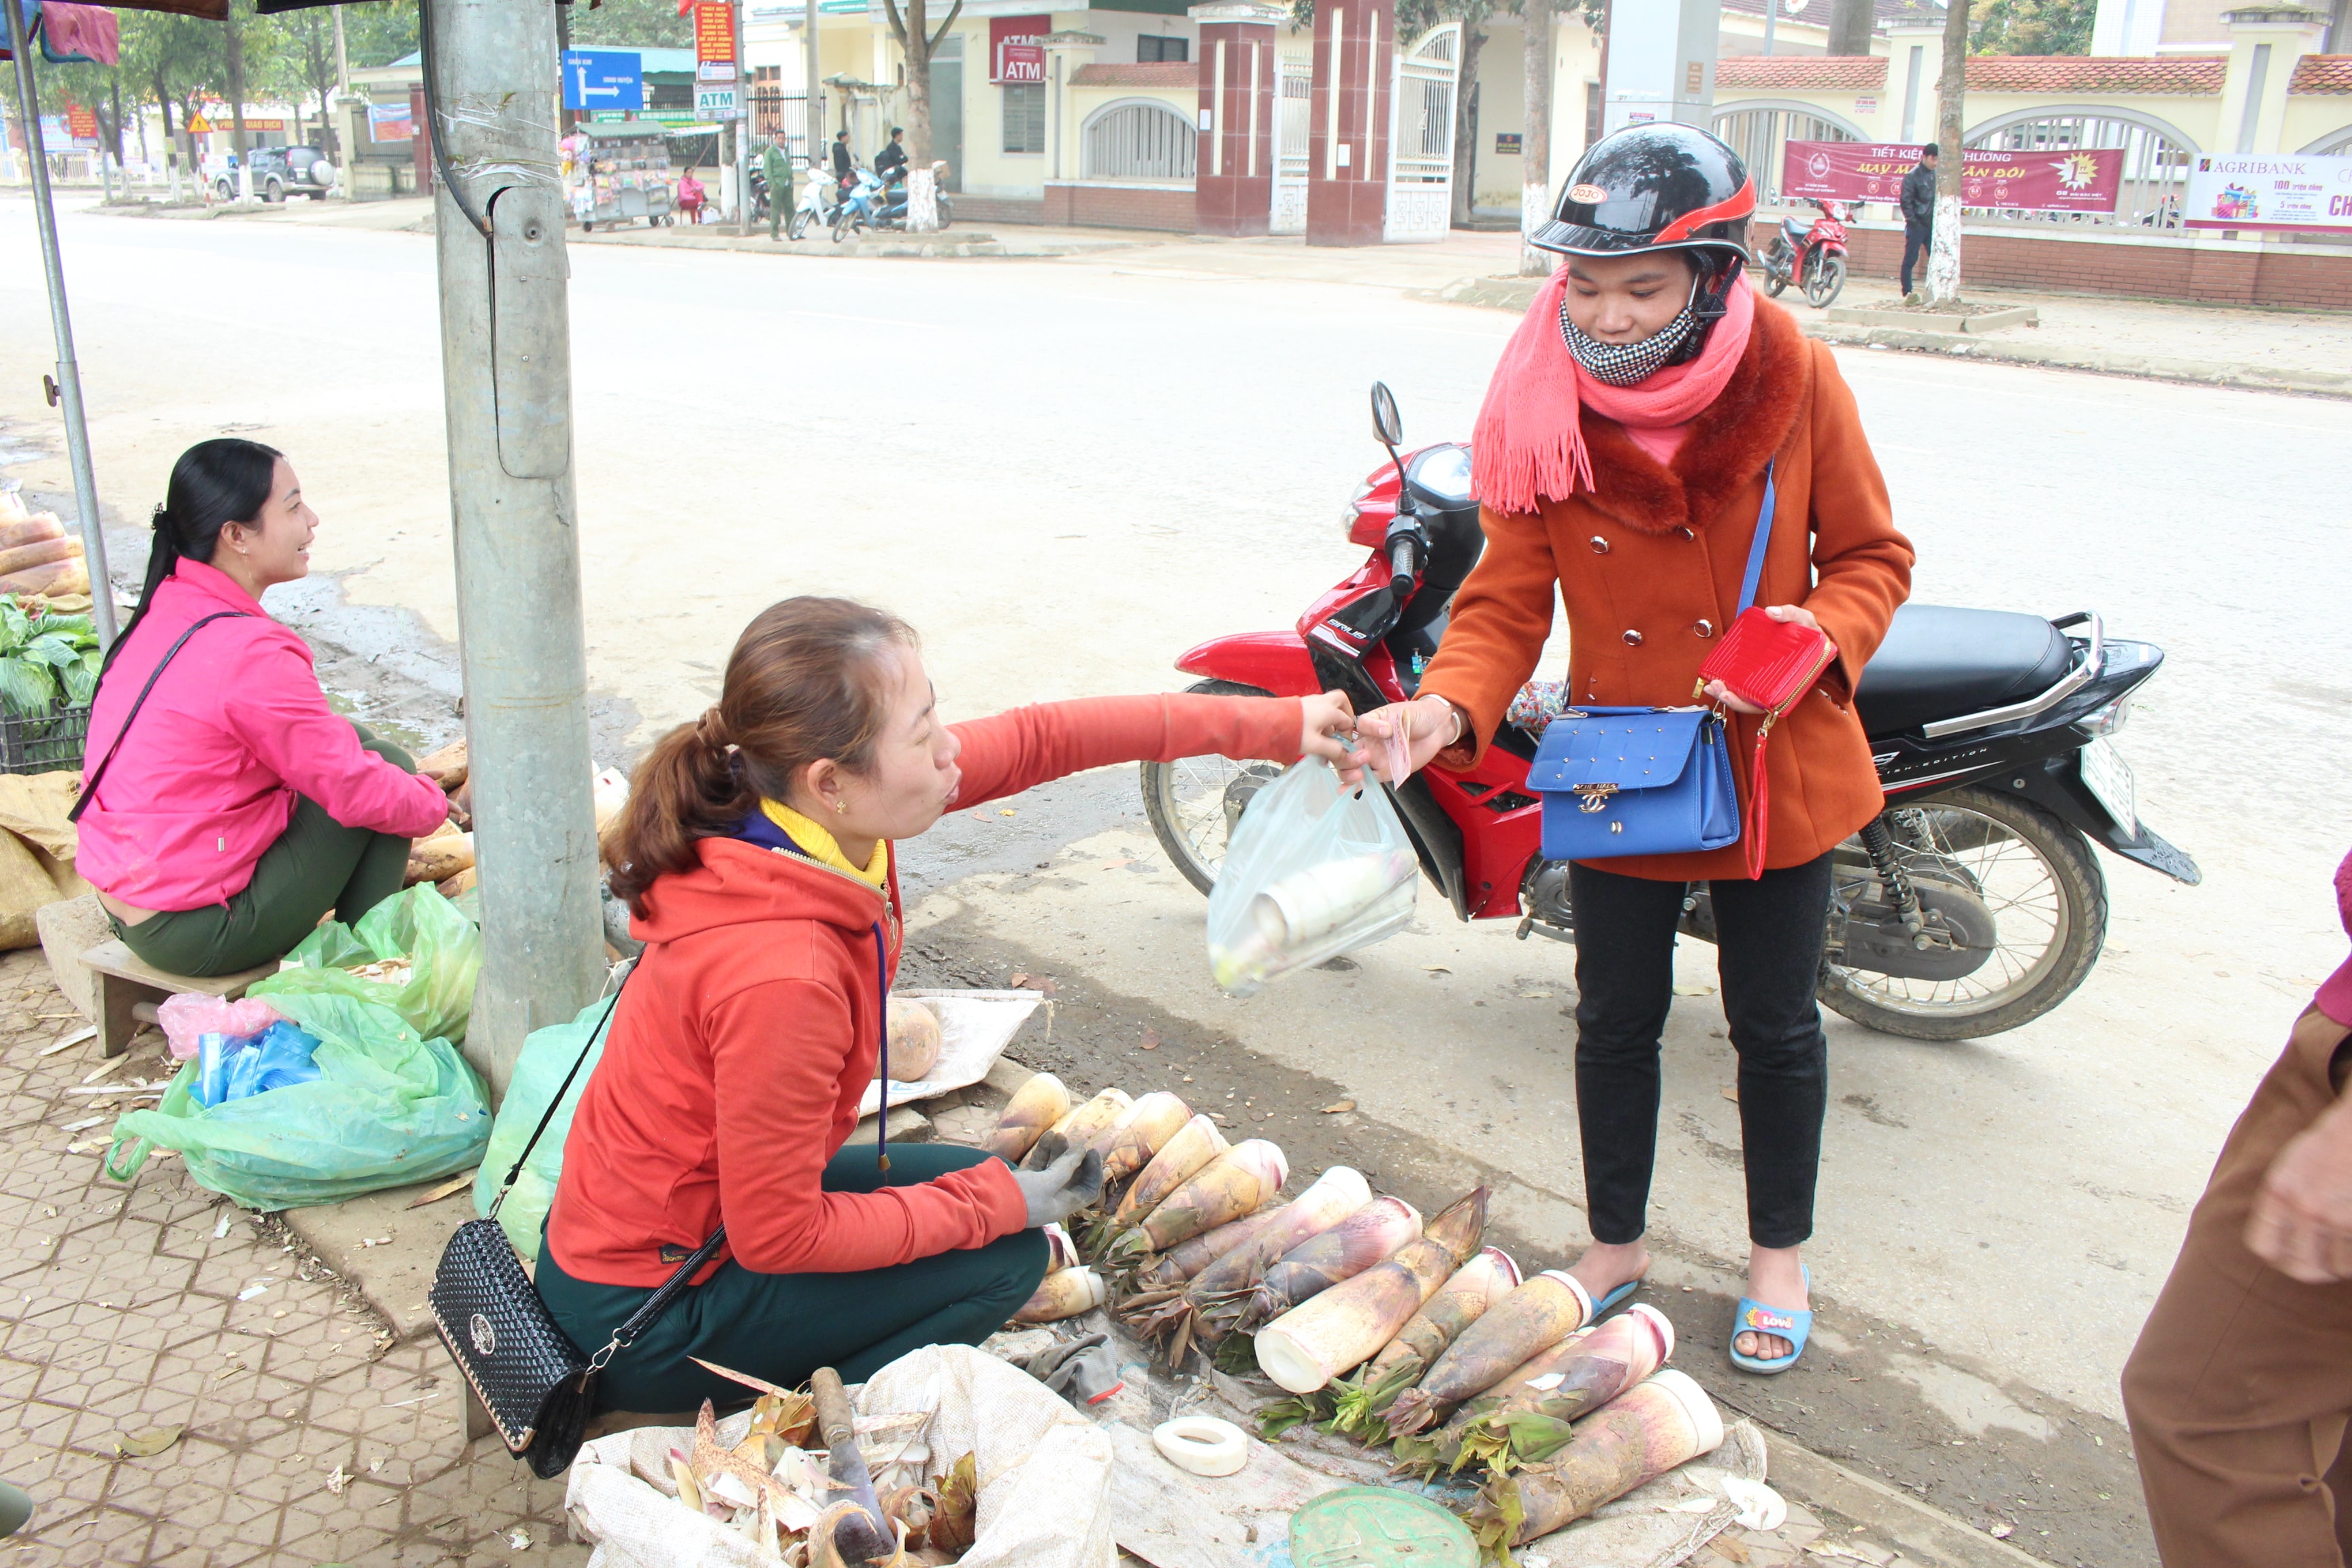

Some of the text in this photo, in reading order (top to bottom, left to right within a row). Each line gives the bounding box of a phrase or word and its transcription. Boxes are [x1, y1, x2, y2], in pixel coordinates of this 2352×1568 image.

[1006, 61, 1041, 80] ATM
[700, 92, 733, 107] ATM
[246, 120, 263, 129] GIAO
[263, 120, 282, 129] DỊCH
[1871, 146, 1896, 158] TIẾT
[1963, 151, 2012, 162] HƯỞNG
[1857, 163, 1892, 175] MAY
[1993, 166, 2026, 178] ĐÔI
[2213, 161, 2307, 175] AGRIBANK
[2274, 180, 2290, 190] 100
[2308, 183, 2323, 191] đồng
[1573, 188, 1599, 199] JOJO
[1327, 618, 1367, 640] SIRIUS
